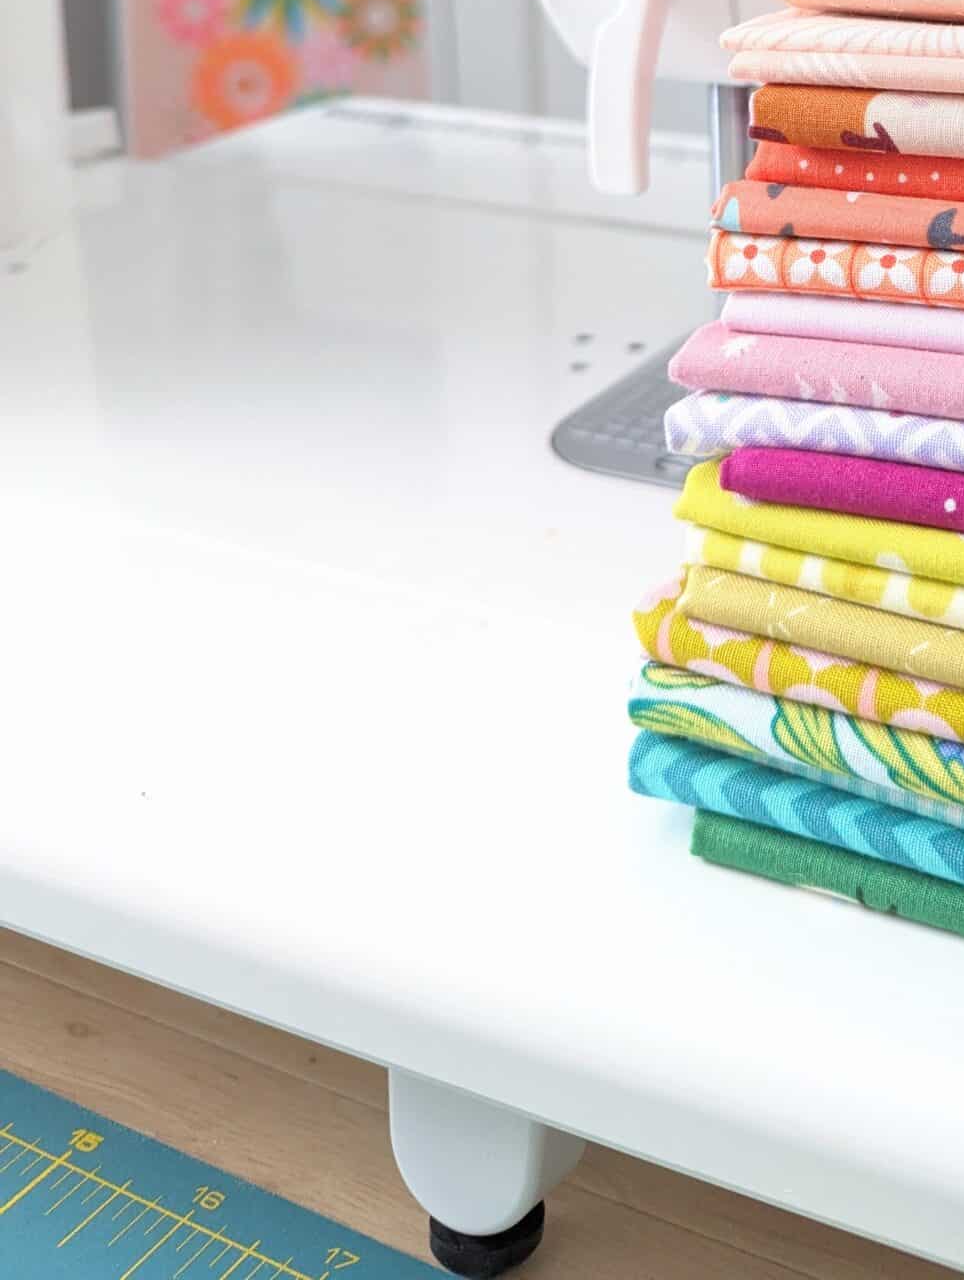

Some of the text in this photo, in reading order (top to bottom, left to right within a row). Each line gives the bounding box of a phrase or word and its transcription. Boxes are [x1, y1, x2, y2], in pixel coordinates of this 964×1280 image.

[69, 1128, 361, 1269] 15 16 17
